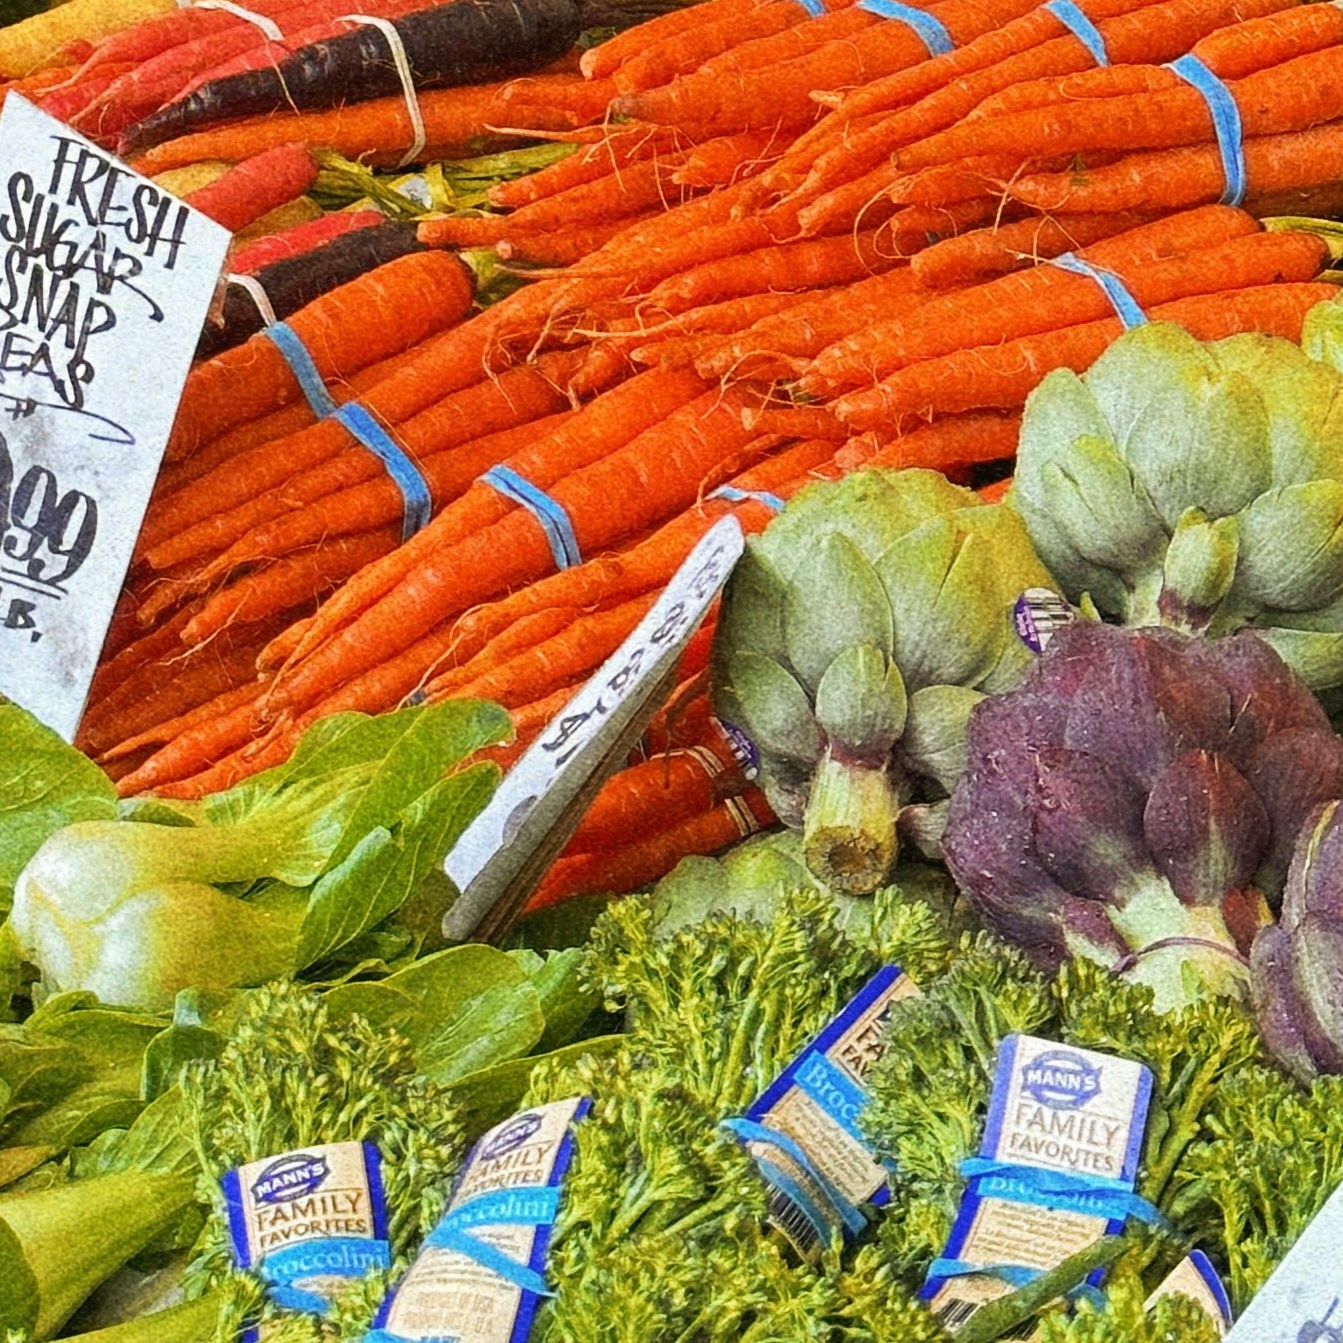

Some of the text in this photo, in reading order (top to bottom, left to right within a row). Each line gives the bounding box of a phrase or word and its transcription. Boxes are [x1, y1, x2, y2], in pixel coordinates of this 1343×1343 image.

[49, 135, 190, 271] FRESH
[1026, 1070, 1097, 1092] MANN'S
[1015, 1102, 1122, 1151] FAMILY
[1009, 1131, 1115, 1172] FAVORITES
[257, 1162, 325, 1198] MANN'S
[258, 1191, 362, 1232] FAMILY
[260, 1217, 367, 1249] FAVORITES
[262, 1244, 384, 1278] roccolini
